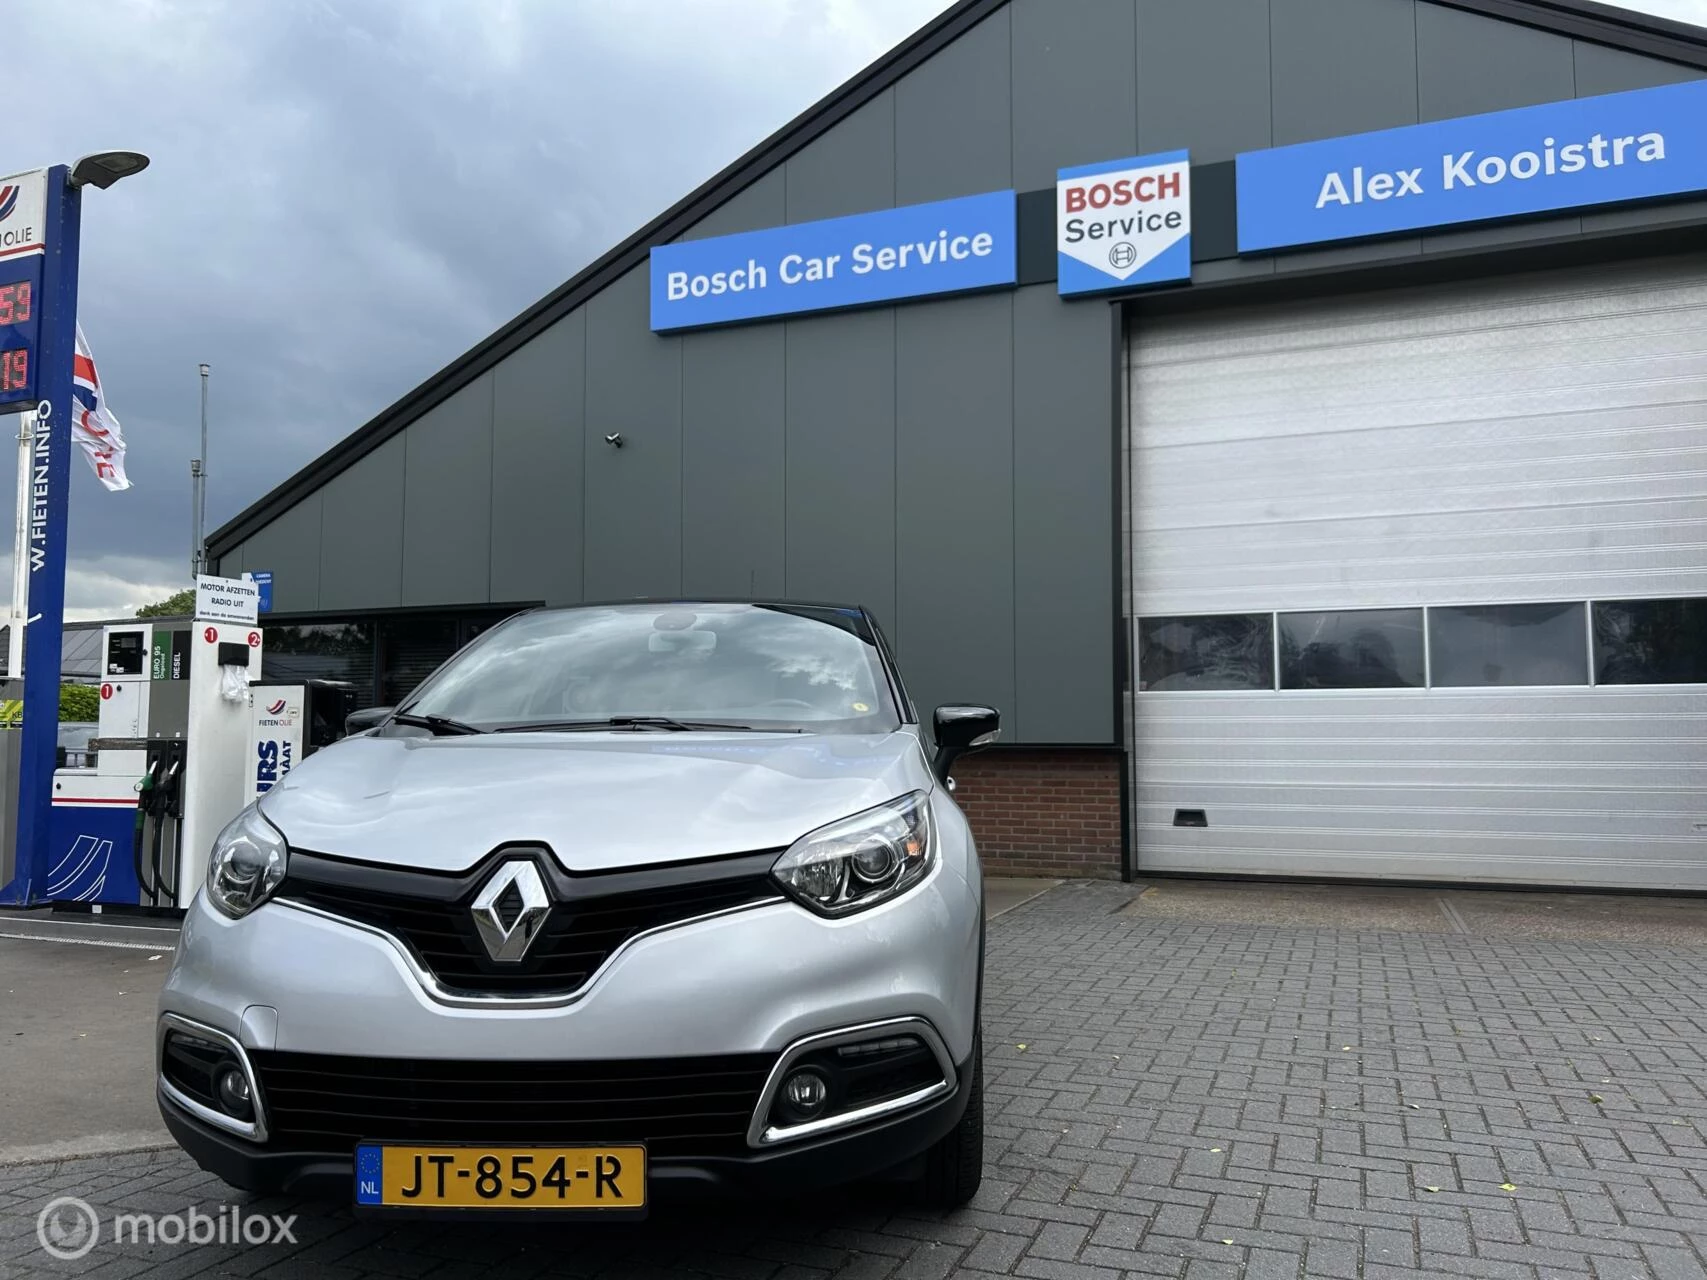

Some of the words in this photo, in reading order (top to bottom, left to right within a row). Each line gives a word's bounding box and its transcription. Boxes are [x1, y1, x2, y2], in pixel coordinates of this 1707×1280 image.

[1315, 167, 1423, 208] Alex
[1442, 132, 1666, 191] Kooistra
[1066, 172, 1180, 213] BOSCH
[1065, 210, 1182, 243] Service
[667, 258, 767, 301] Bosch
[779, 254, 840, 284] Car
[851, 230, 993, 274] Service
[200, 582, 225, 592] MOTOR
[226, 586, 256, 596] AFZETTEN
[211, 597, 232, 607] RADIO
[154, 645, 161, 656] 95
[173, 652, 181, 679] DIESEL
[153, 658, 161, 679] EURO
[361, 1181, 379, 1194] NL
[401, 1154, 624, 1199] JT-854-R
